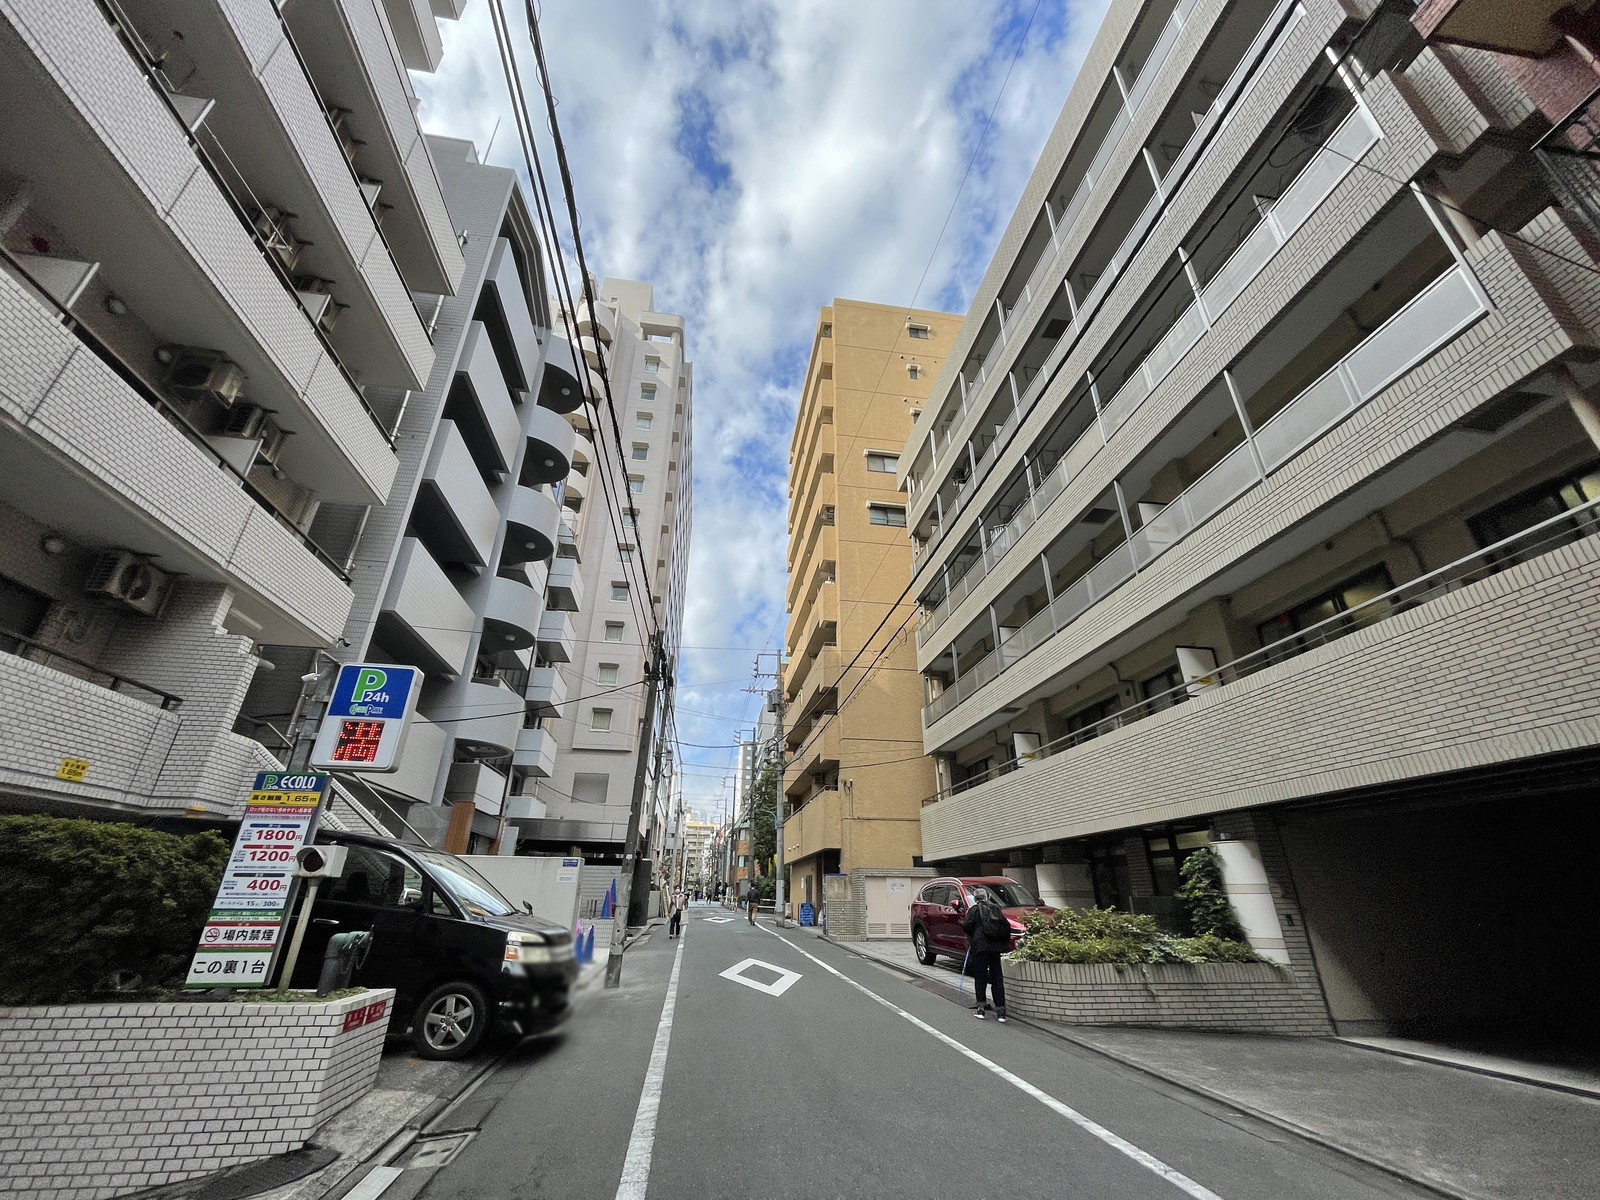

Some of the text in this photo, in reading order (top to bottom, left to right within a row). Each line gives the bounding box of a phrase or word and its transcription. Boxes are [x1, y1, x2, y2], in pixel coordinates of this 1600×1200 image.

[350, 668, 387, 702] P
[364, 691, 390, 703] 24h
[262, 774, 317, 790] P ECOLO
[222, 929, 275, 941] 場内禁煙
[193, 959, 266, 975] この裏1台
